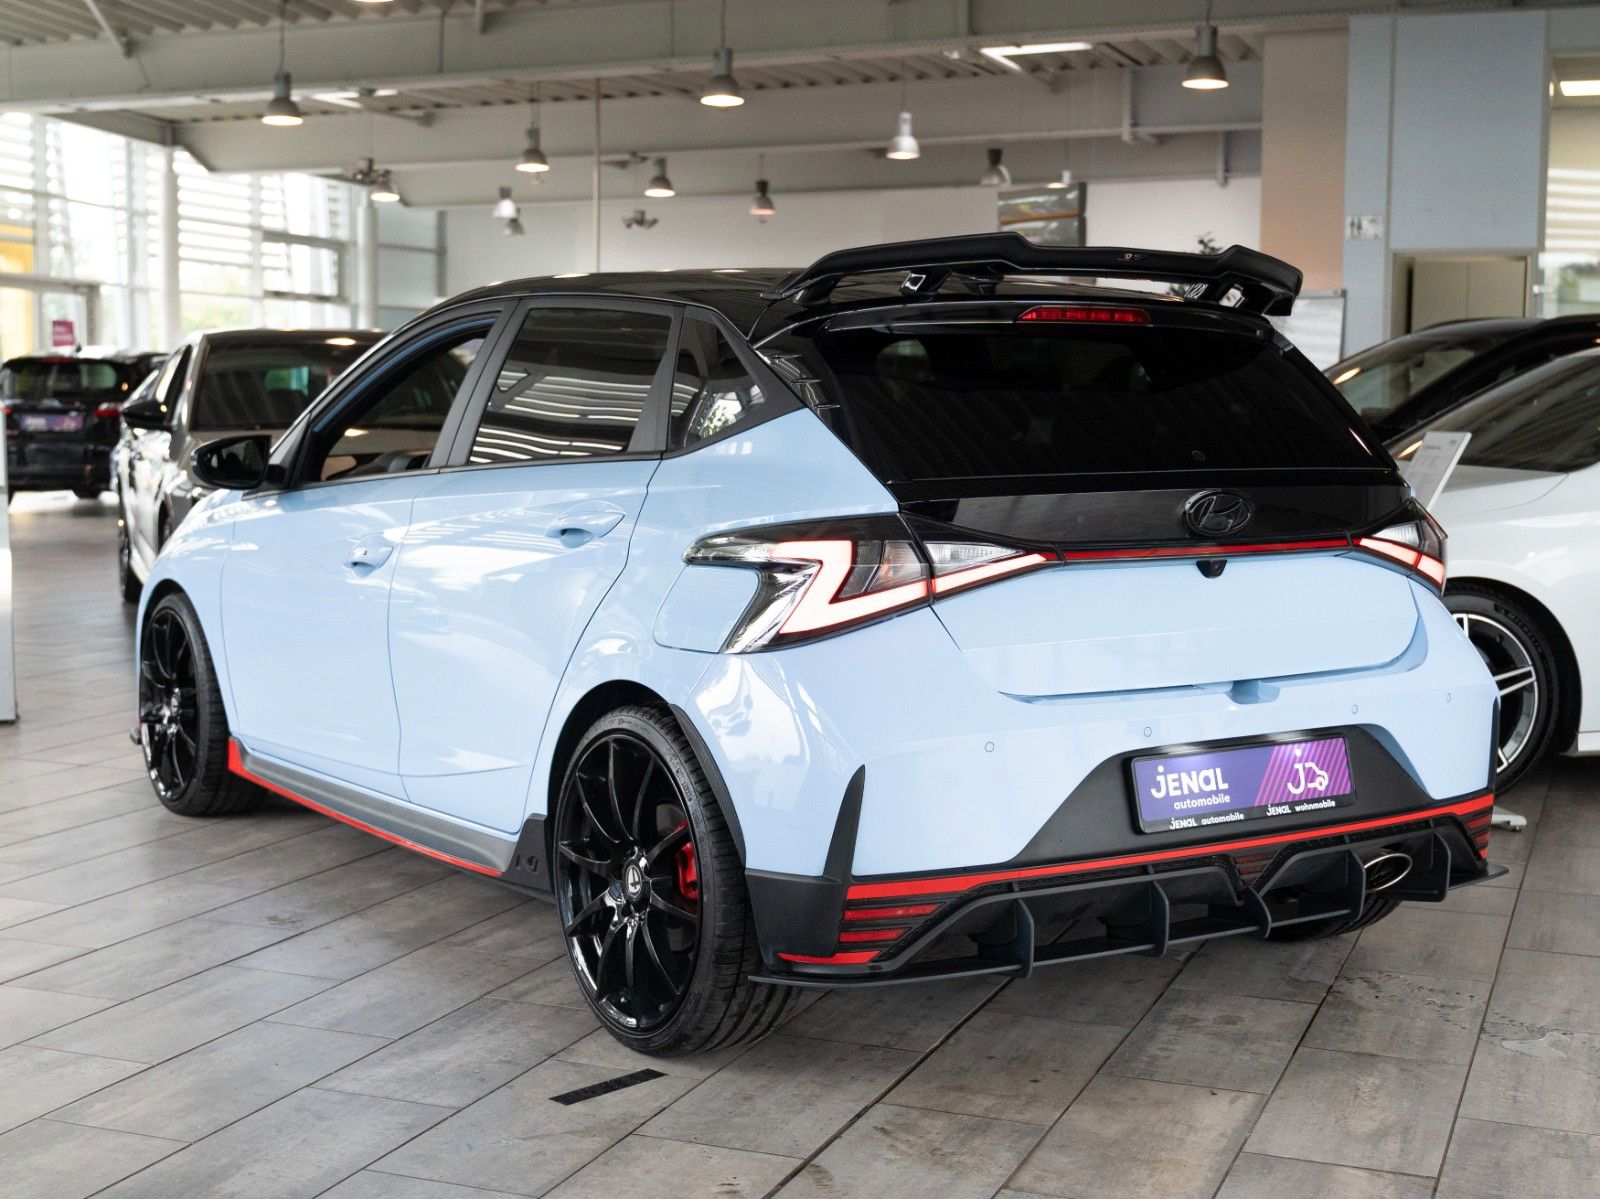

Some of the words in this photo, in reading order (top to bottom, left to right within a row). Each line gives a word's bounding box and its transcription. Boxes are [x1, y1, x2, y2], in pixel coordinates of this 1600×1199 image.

[1173, 793, 1231, 810] automobile
[1294, 799, 1336, 812] wohnmobile
[1201, 812, 1245, 825] automobile
